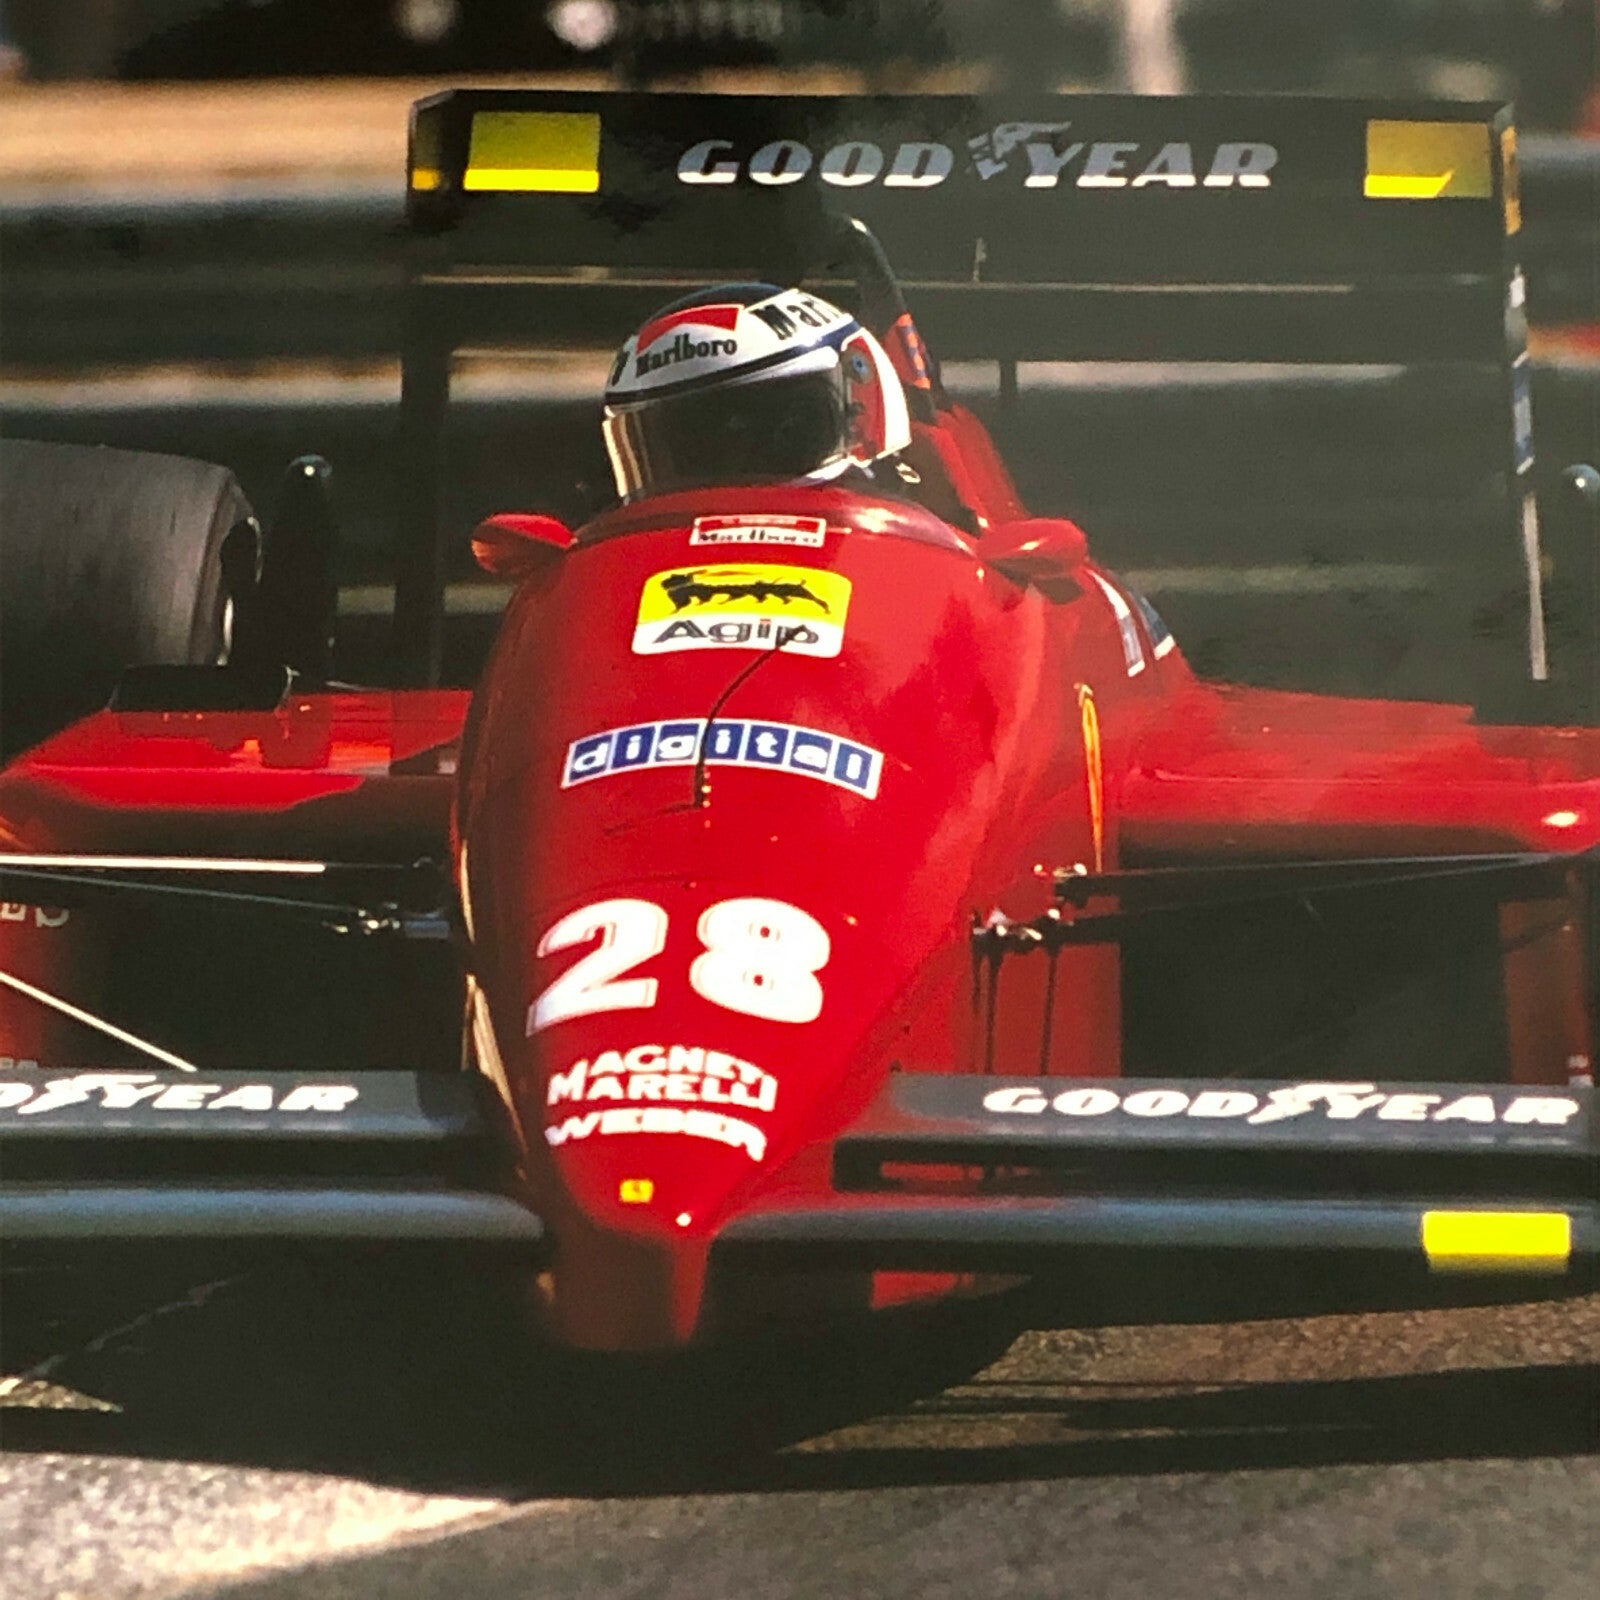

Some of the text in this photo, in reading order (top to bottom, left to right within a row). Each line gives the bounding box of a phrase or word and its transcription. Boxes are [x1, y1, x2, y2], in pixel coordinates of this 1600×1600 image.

[636, 333, 738, 378] Marlboro
[652, 617, 820, 650] Agip
[570, 725, 868, 786] digital
[526, 897, 831, 1037] 28
